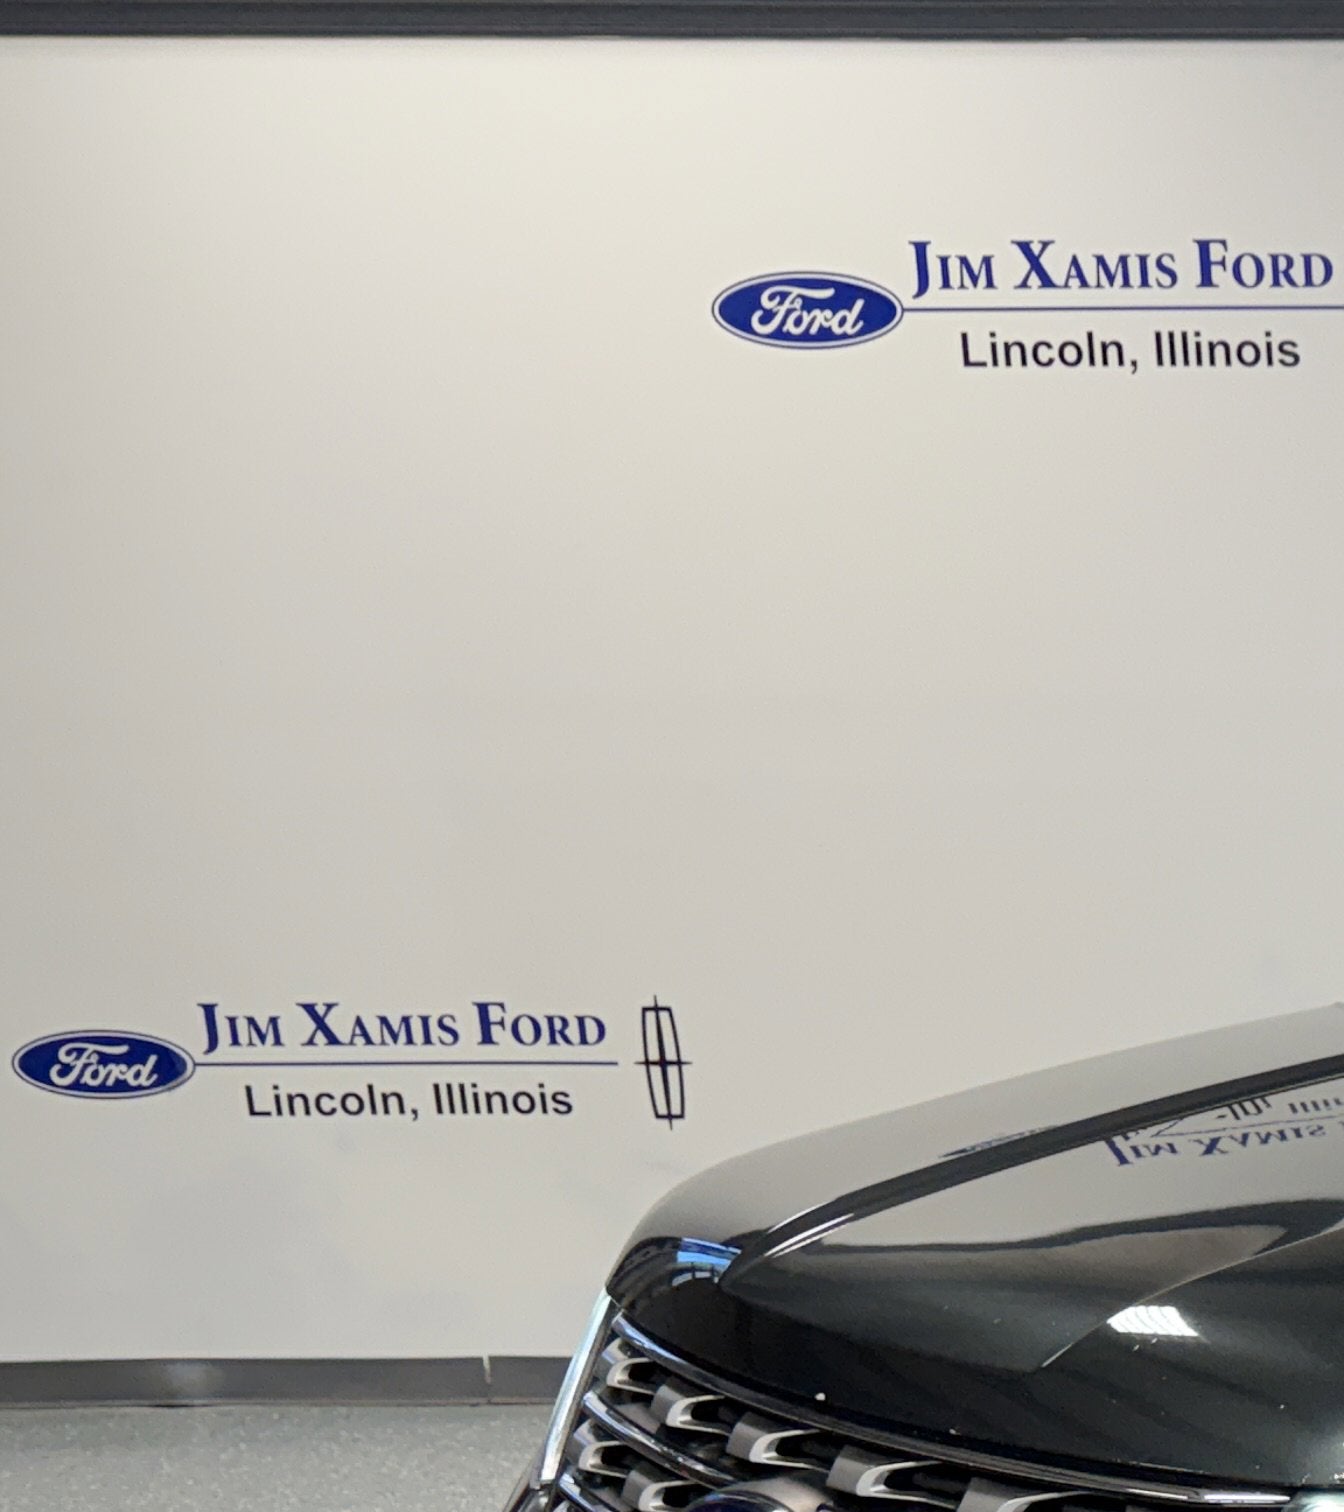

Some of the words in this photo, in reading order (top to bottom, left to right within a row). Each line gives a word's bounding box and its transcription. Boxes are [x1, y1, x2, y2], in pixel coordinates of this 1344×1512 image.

[750, 285, 865, 336] Ford
[960, 331, 1138, 375] Lincoln,
[1154, 330, 1301, 368] Illinois
[49, 1041, 159, 1089] Ford
[244, 1083, 419, 1121] Lincoln,
[432, 1082, 573, 1116] Illinois
